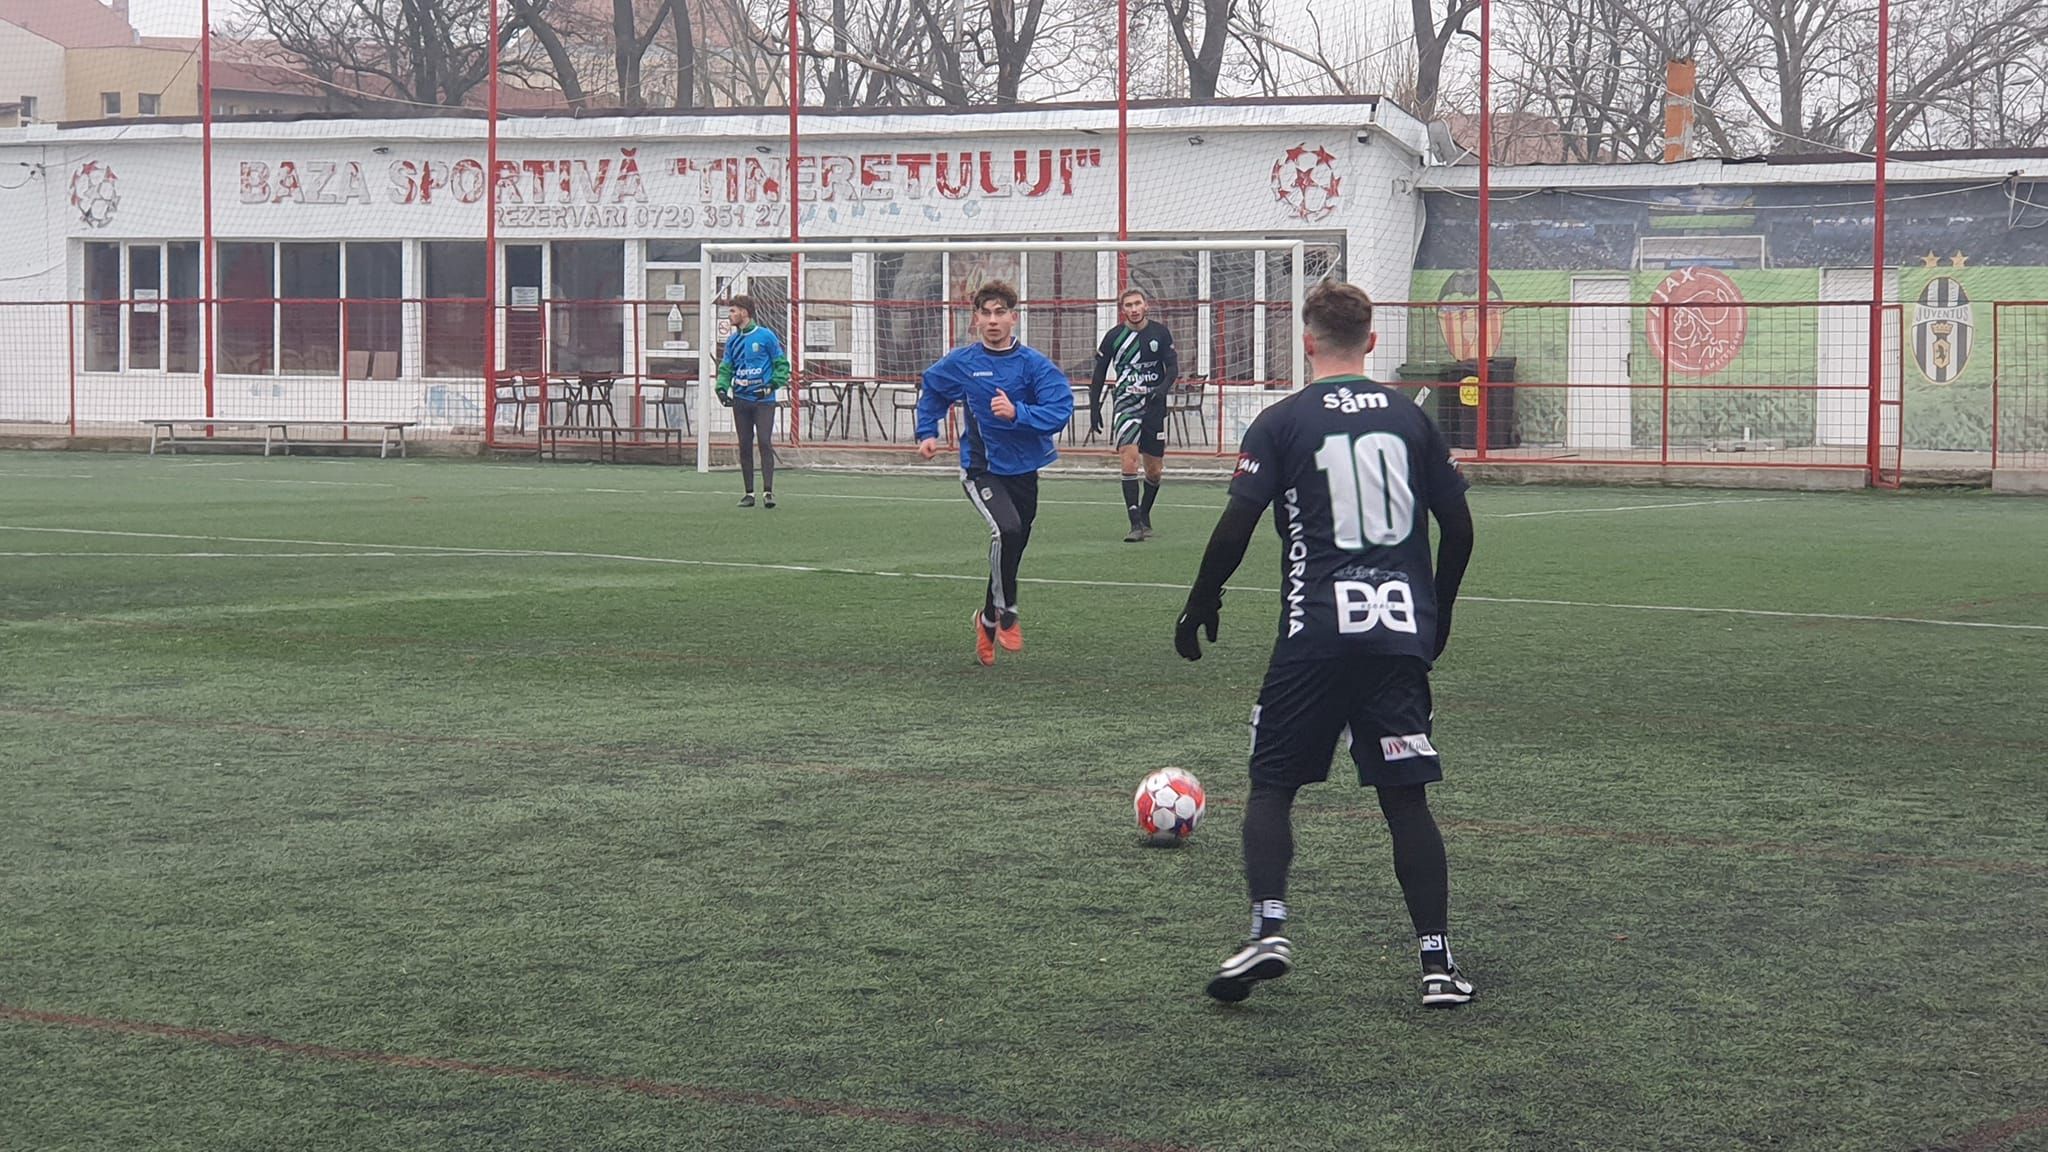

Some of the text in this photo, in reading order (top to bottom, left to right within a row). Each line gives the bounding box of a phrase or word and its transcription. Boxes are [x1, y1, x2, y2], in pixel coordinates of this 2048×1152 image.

[239, 161, 371, 205] BAZA
[388, 148, 649, 205] SPORTIVĂ
[634, 205, 695, 229] 0729
[703, 204, 745, 228] 351
[1647, 266, 1695, 318] AJAX
[1916, 305, 1969, 322] JUVENTUS
[1315, 432, 1415, 550] 10
[1284, 486, 1308, 639] PANORAMA
